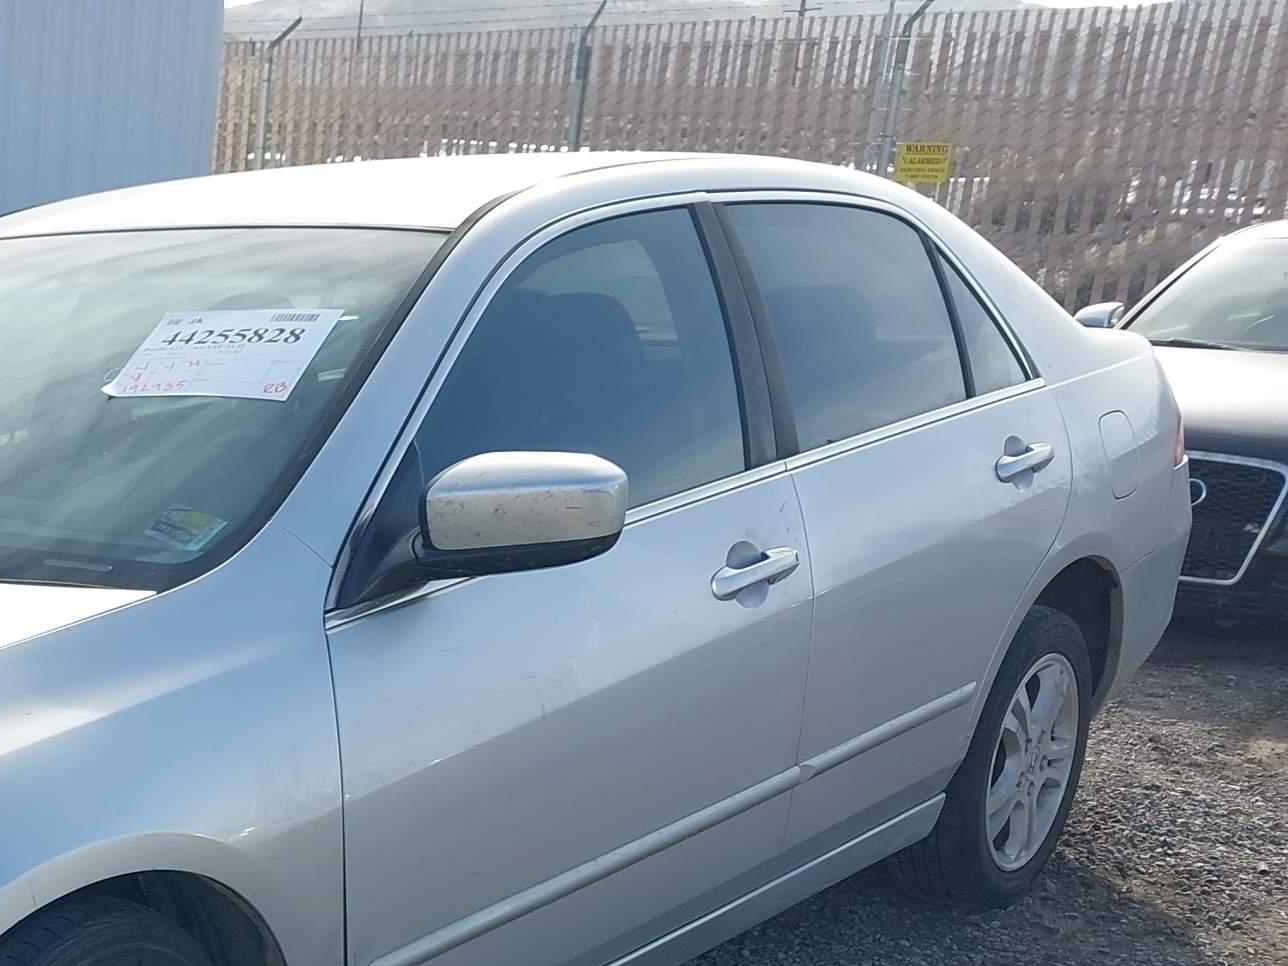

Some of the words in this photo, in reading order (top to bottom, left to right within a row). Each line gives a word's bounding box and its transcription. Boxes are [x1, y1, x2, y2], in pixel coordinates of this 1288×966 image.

[905, 144, 948, 153] WARNING
[909, 157, 941, 165] ALARMED
[161, 327, 306, 346] 44255828
